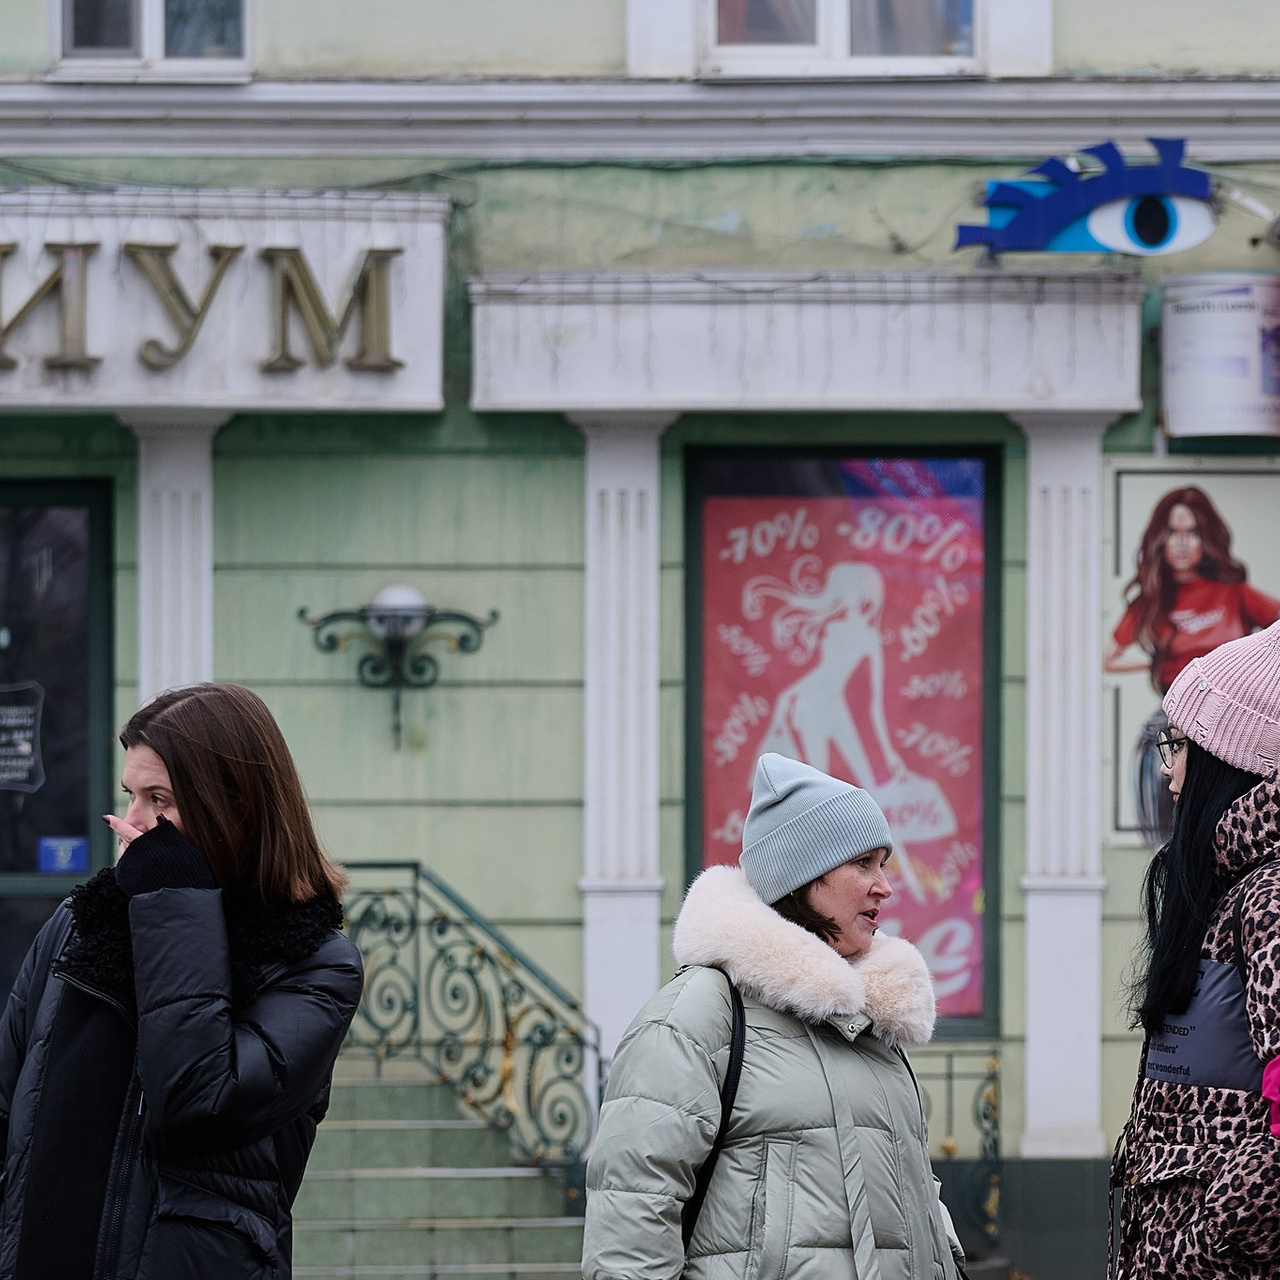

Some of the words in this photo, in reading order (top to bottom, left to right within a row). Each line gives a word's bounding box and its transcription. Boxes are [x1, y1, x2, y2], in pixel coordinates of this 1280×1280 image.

[719, 508, 820, 564] -70%
[836, 506, 969, 574] -80%
[1155, 1062, 1192, 1077] wonderful
